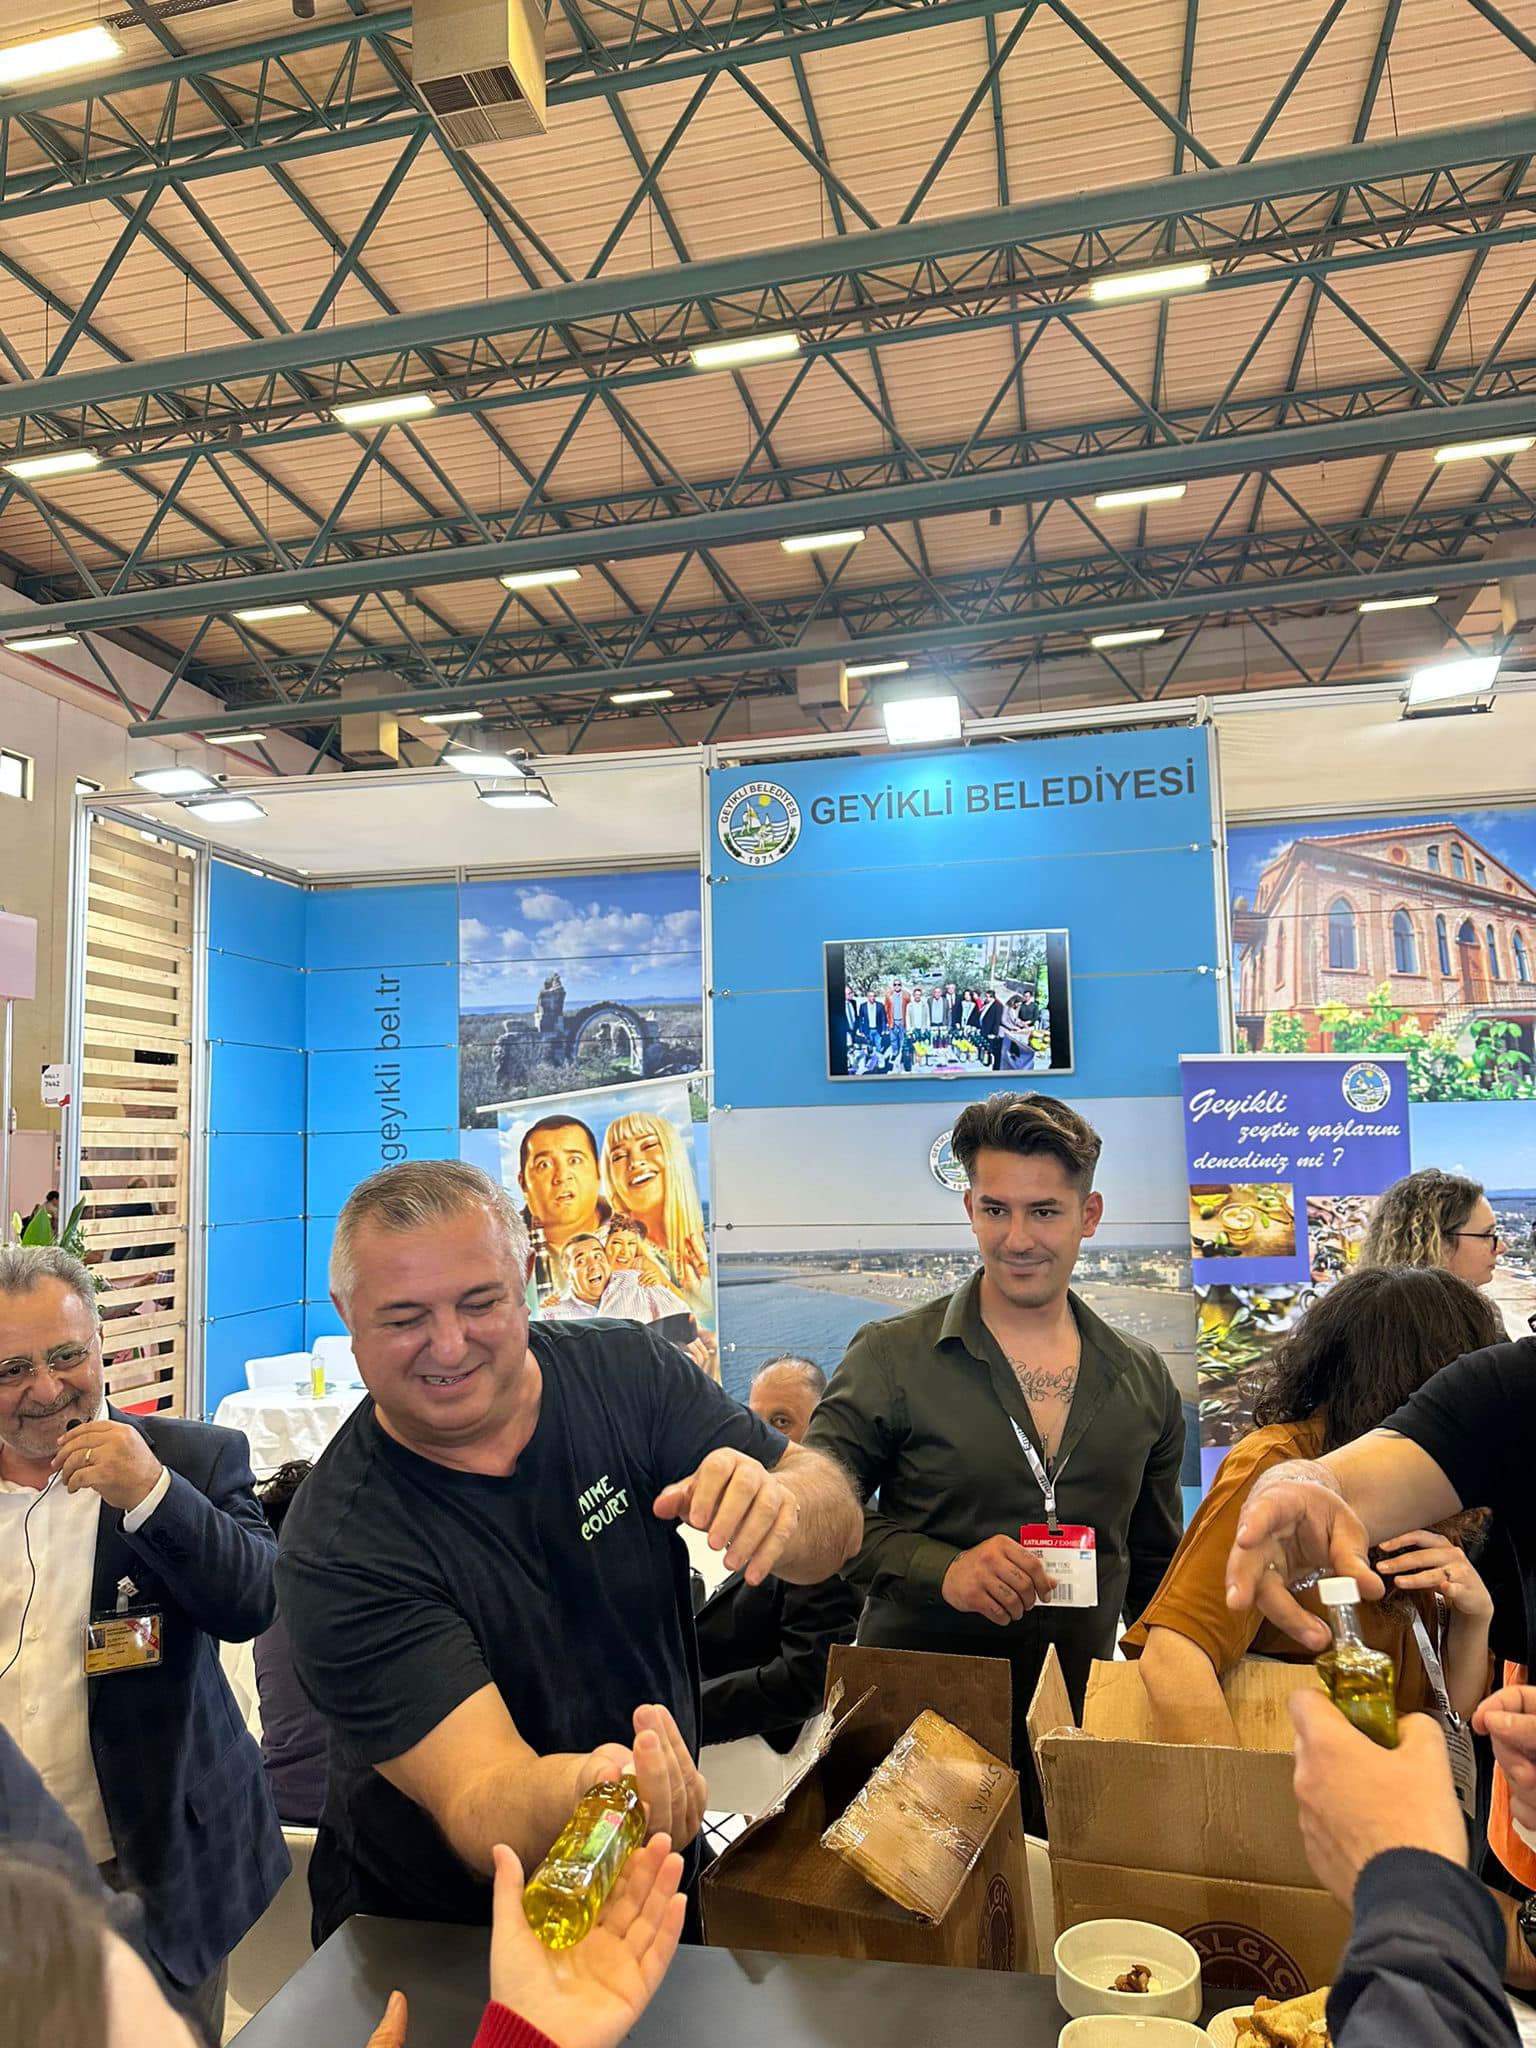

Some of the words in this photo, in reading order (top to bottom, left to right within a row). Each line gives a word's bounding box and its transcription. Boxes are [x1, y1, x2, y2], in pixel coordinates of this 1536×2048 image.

[749, 783, 799, 818] BELEDİYESİ
[811, 779, 952, 825] GEYİKLİ
[966, 758, 1195, 813] BELEDİYESİ
[748, 854, 775, 864] 1971
[374, 973, 400, 1050] bel.tr
[1189, 1088, 1289, 1123] Geyikli
[1237, 1122, 1301, 1144] zeytin
[1306, 1119, 1402, 1143] yağlarını
[1193, 1151, 1290, 1175] denediniz
[1296, 1154, 1324, 1168] mi
[1332, 1147, 1345, 1167] ?
[577, 1474, 615, 1516] NIKE
[581, 1488, 629, 1541] COURT
[1190, 1932, 1297, 1993] ALGIC
